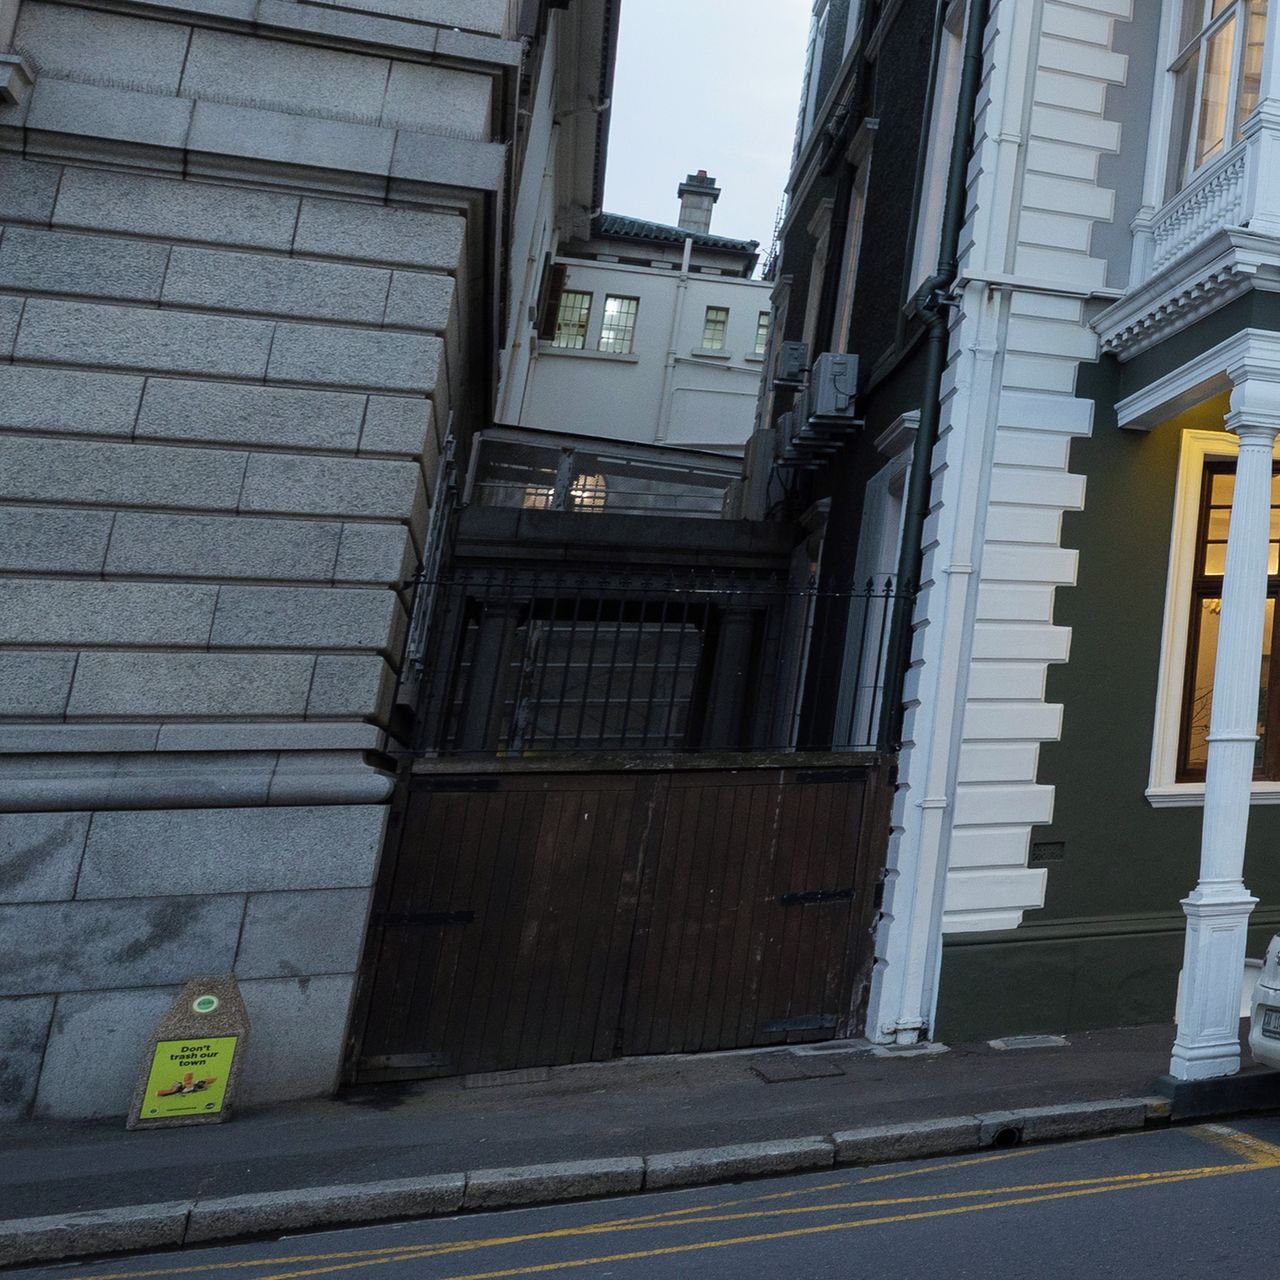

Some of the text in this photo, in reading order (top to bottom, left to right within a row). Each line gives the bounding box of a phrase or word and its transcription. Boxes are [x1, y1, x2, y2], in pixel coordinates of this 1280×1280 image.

[181, 1045, 210, 1053] Don't
[170, 1052, 198, 1060] trash
[179, 1059, 206, 1067] town
